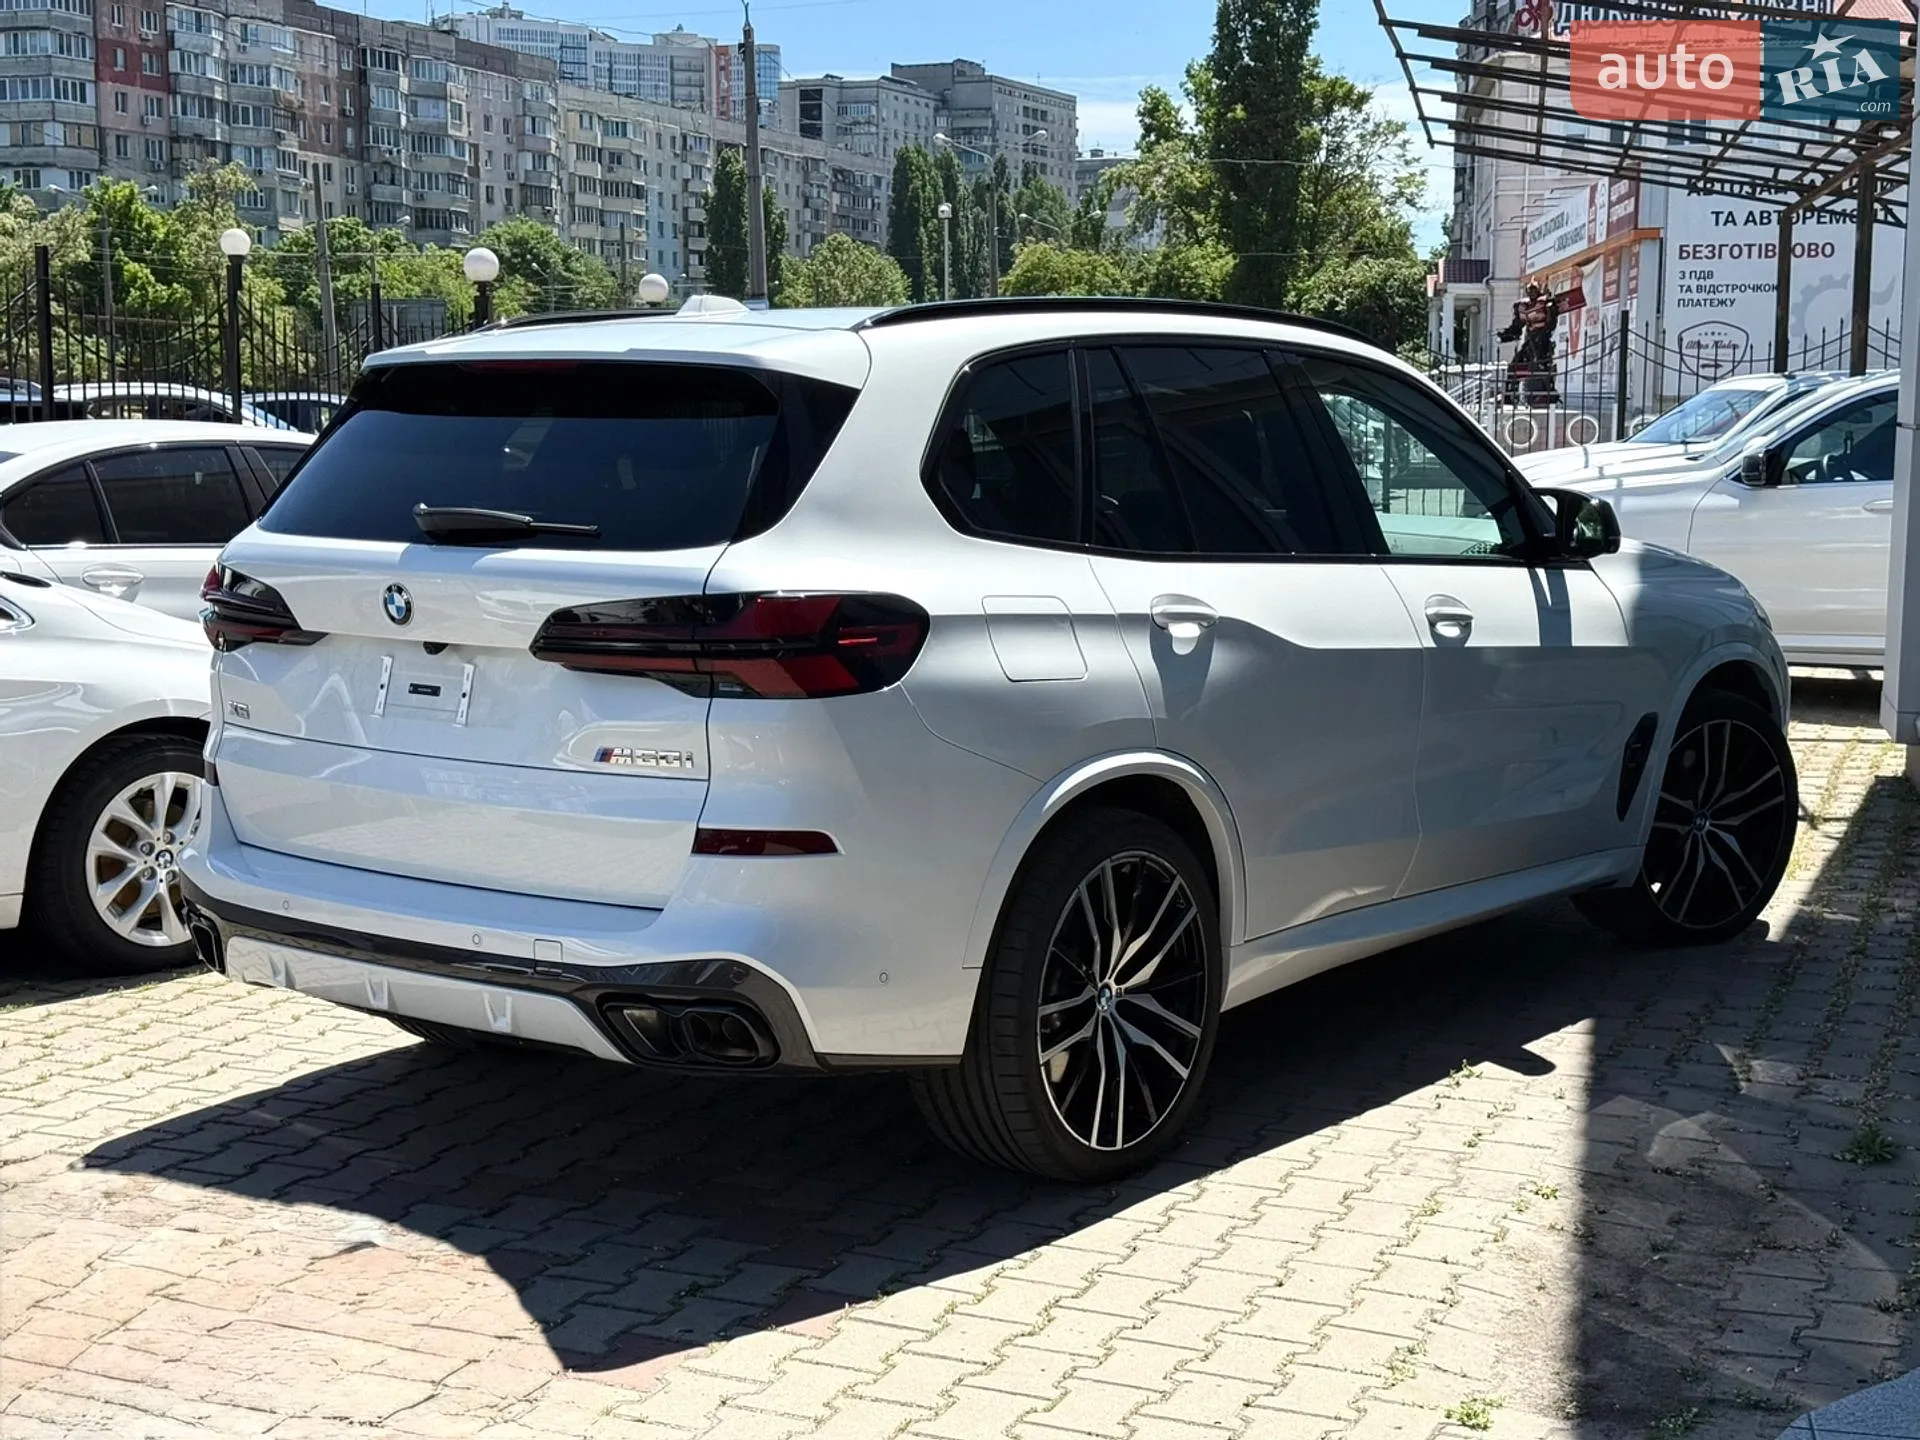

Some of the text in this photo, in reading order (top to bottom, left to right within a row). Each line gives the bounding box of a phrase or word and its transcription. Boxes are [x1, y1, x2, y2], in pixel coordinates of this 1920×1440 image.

[1711, 210, 1737, 226] ТА
[1678, 242, 1835, 260] БЕЗГОТІВОВО
[1689, 270, 1714, 281] ПДВ
[1679, 284, 1693, 294] ТА
[1677, 298, 1736, 308] ПЛАТЕЖУ
